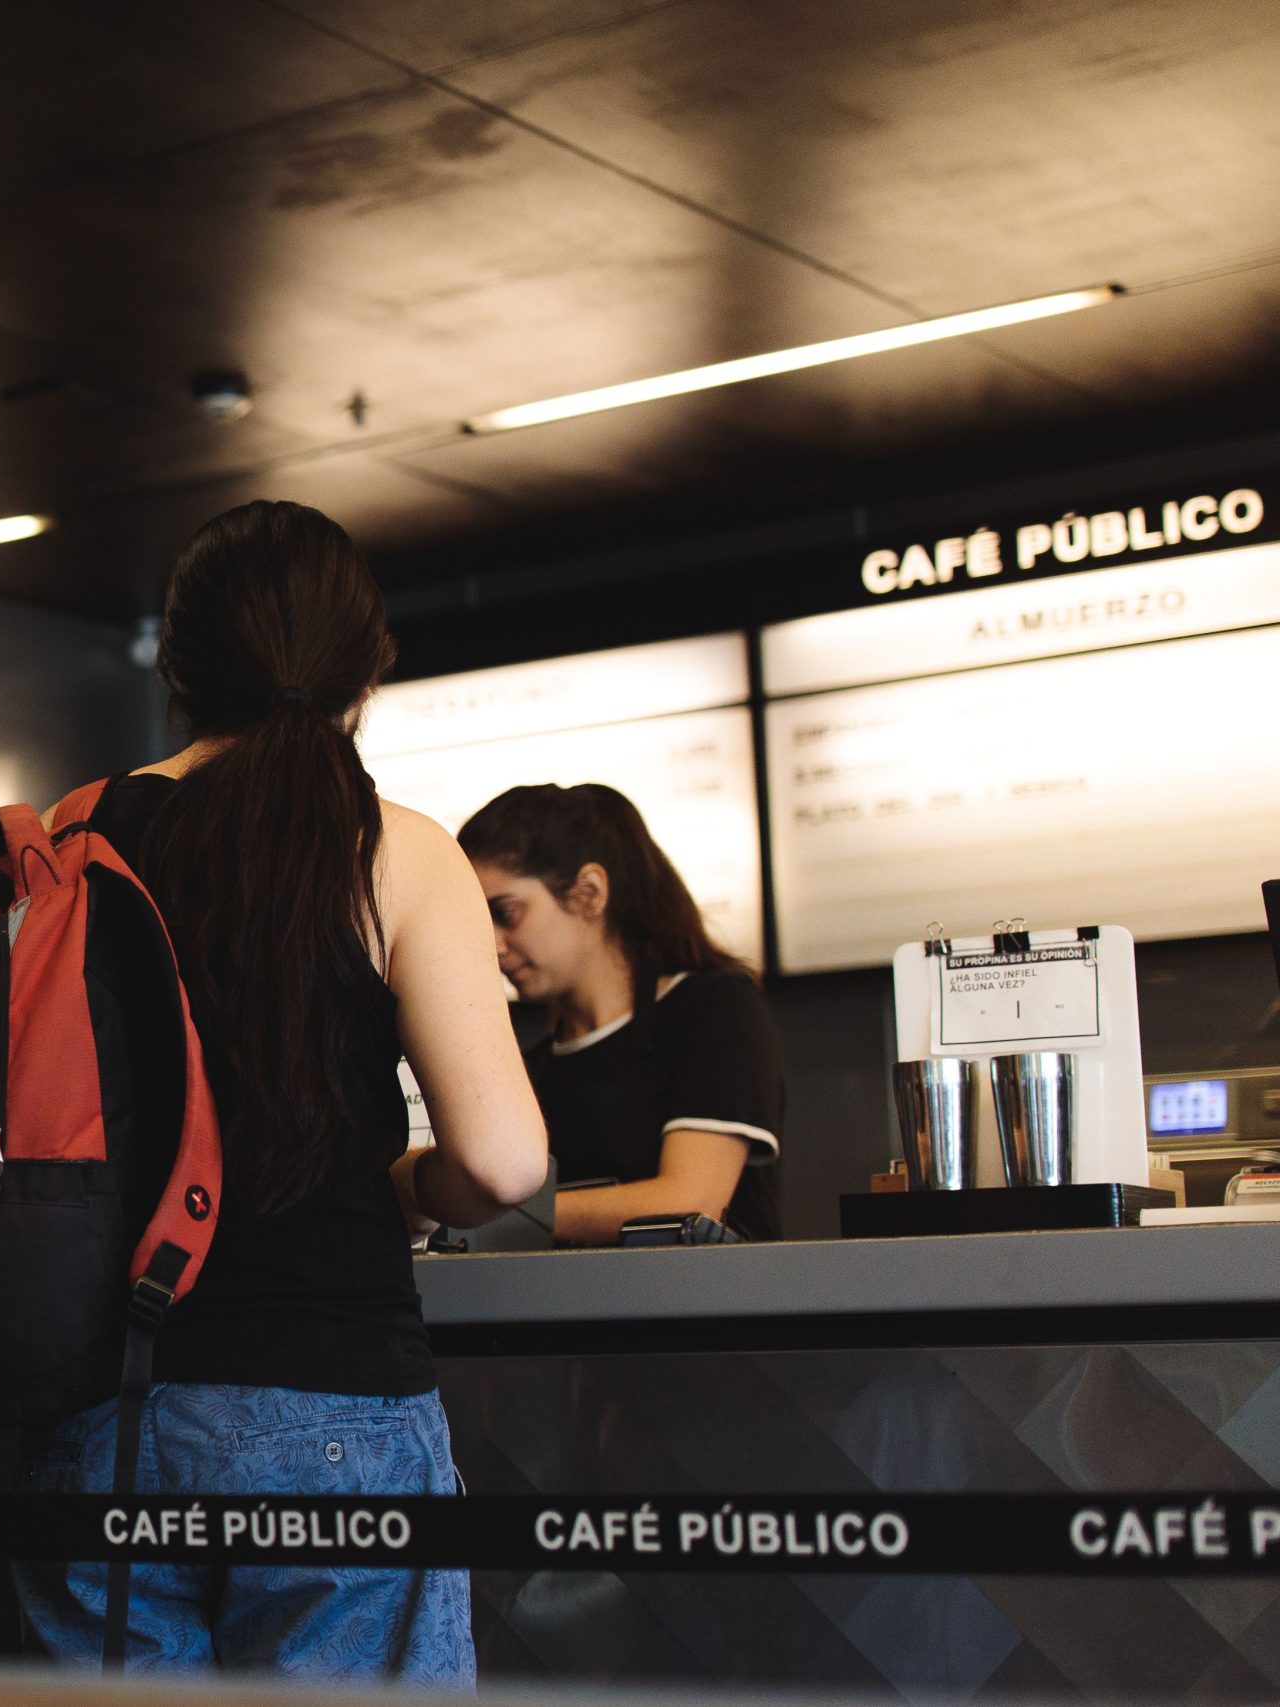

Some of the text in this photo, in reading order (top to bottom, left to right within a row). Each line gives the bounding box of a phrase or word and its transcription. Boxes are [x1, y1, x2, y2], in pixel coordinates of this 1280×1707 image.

[861, 488, 1264, 594] CAFÉ PÚBLICO
[969, 587, 1186, 643] ALMUERZO
[949, 947, 1083, 968] SU PROPINA ES SU OPINIÓN
[949, 968, 1038, 986] ¿HA SIDO INFIEL
[949, 979, 1026, 993] ALGUNA VEZ?
[103, 1502, 411, 1549] CAFÉ PÚBLICO
[534, 1502, 909, 1557] CAFÉ PÚBLICO
[1070, 1498, 1228, 1556] CAFÉ
